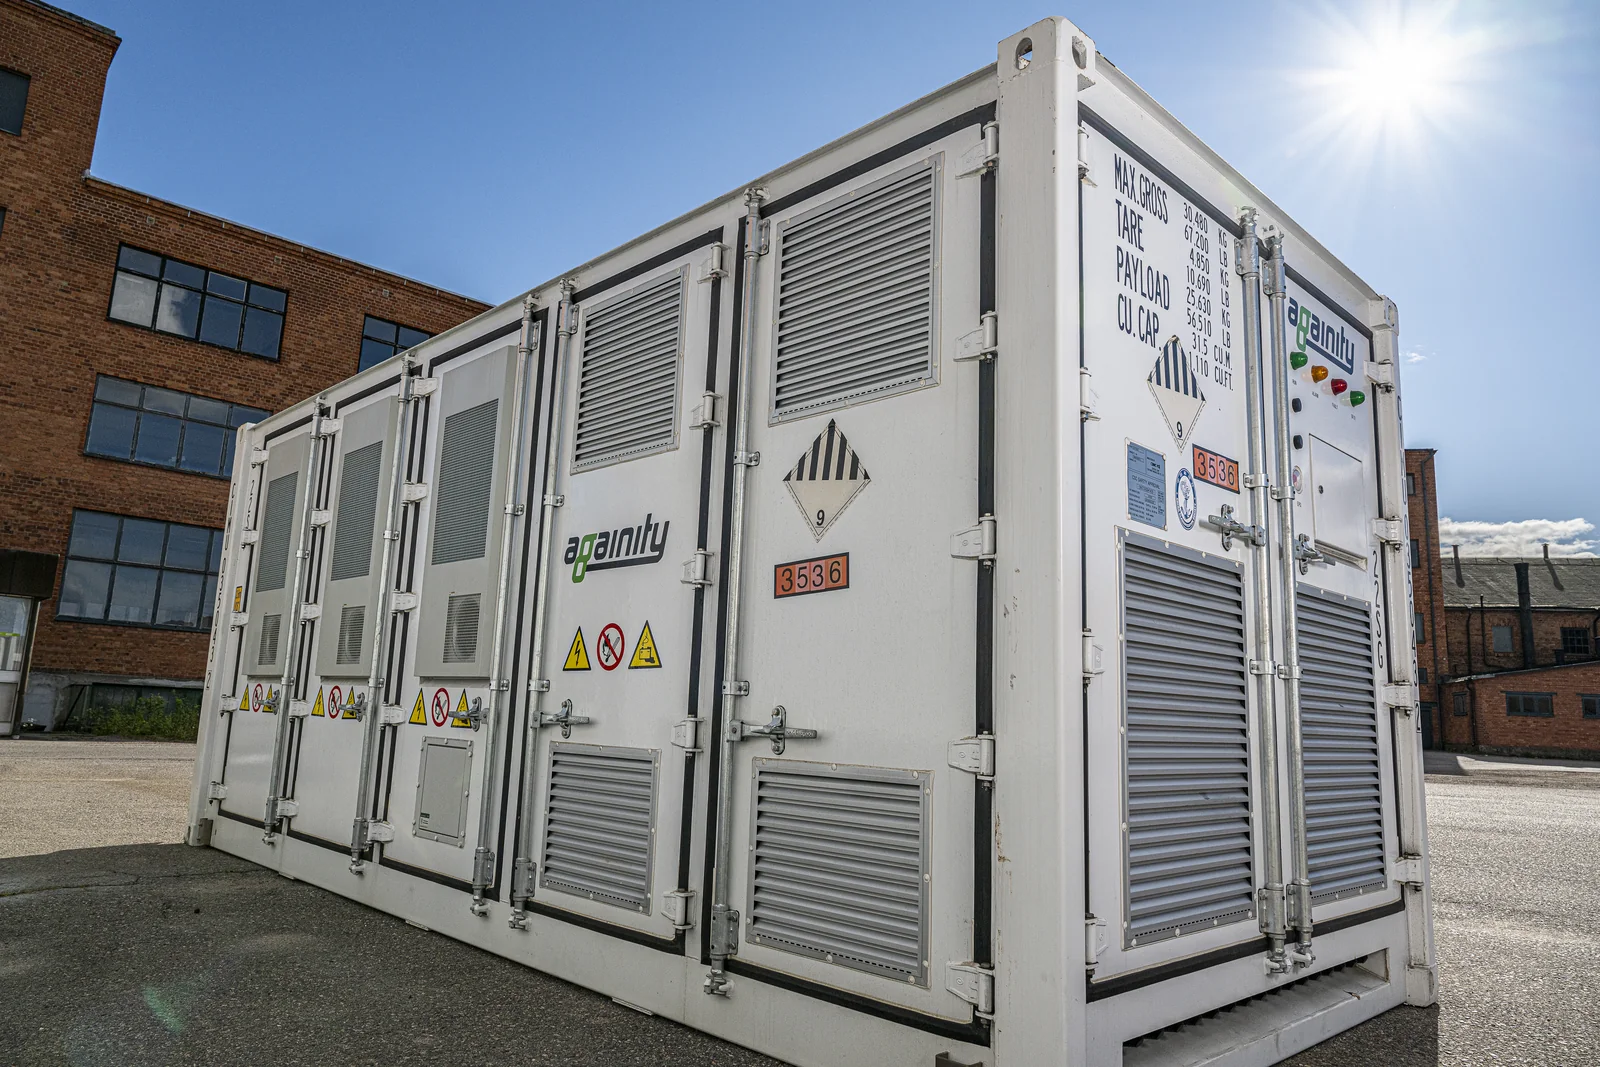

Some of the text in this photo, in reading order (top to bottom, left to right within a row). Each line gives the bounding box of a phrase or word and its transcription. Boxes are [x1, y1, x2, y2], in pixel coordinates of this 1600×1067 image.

[1114, 152, 1228, 248] MAX.GROSS 30.480 KG
[1115, 198, 1230, 288] TARE 4.850 KG
[1184, 224, 1228, 268] 67.200 LB
[1116, 244, 1231, 328] PAYLOAD 25.630 KG
[1186, 265, 1230, 308] 10.690 LB
[1186, 307, 1231, 349] 56.510 LB
[1287, 296, 1355, 376] againity
[1192, 331, 1208, 355] 31.5
[1213, 344, 1233, 371] CU.M.
[1176, 421, 1183, 438] 9
[1197, 451, 1235, 486] 3536
[815, 509, 826, 527] 9
[563, 512, 671, 584] againity
[780, 560, 842, 593] 3536
